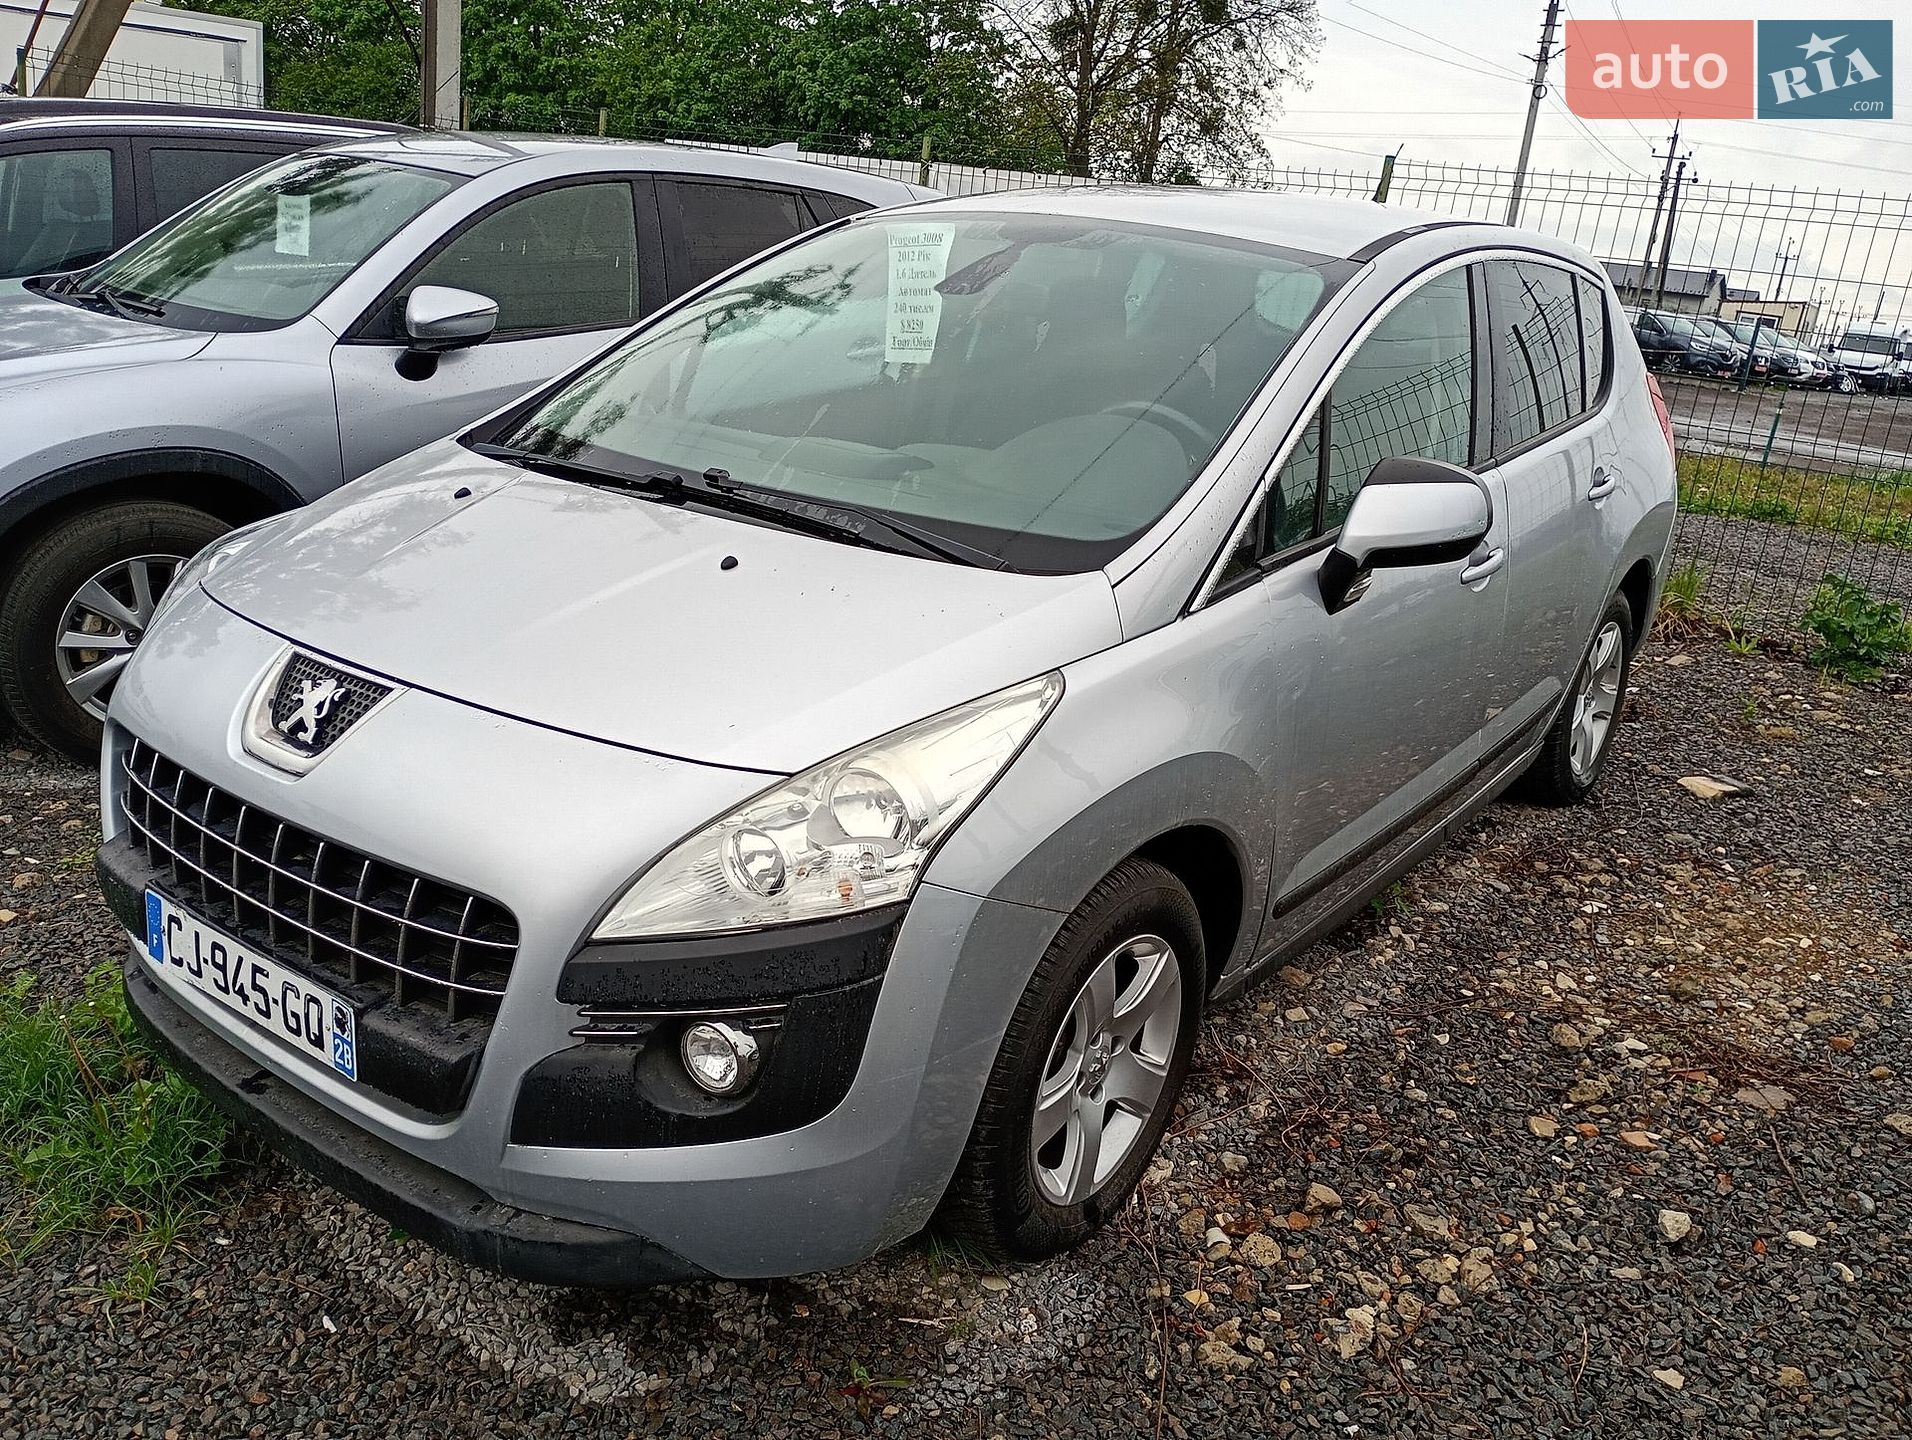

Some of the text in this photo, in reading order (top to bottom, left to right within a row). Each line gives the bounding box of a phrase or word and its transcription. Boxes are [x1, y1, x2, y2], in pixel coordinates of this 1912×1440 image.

[921, 232, 944, 244] 3008
[897, 250, 915, 263] 2012
[152, 913, 353, 1070] F CJ-945-GQ 2B
